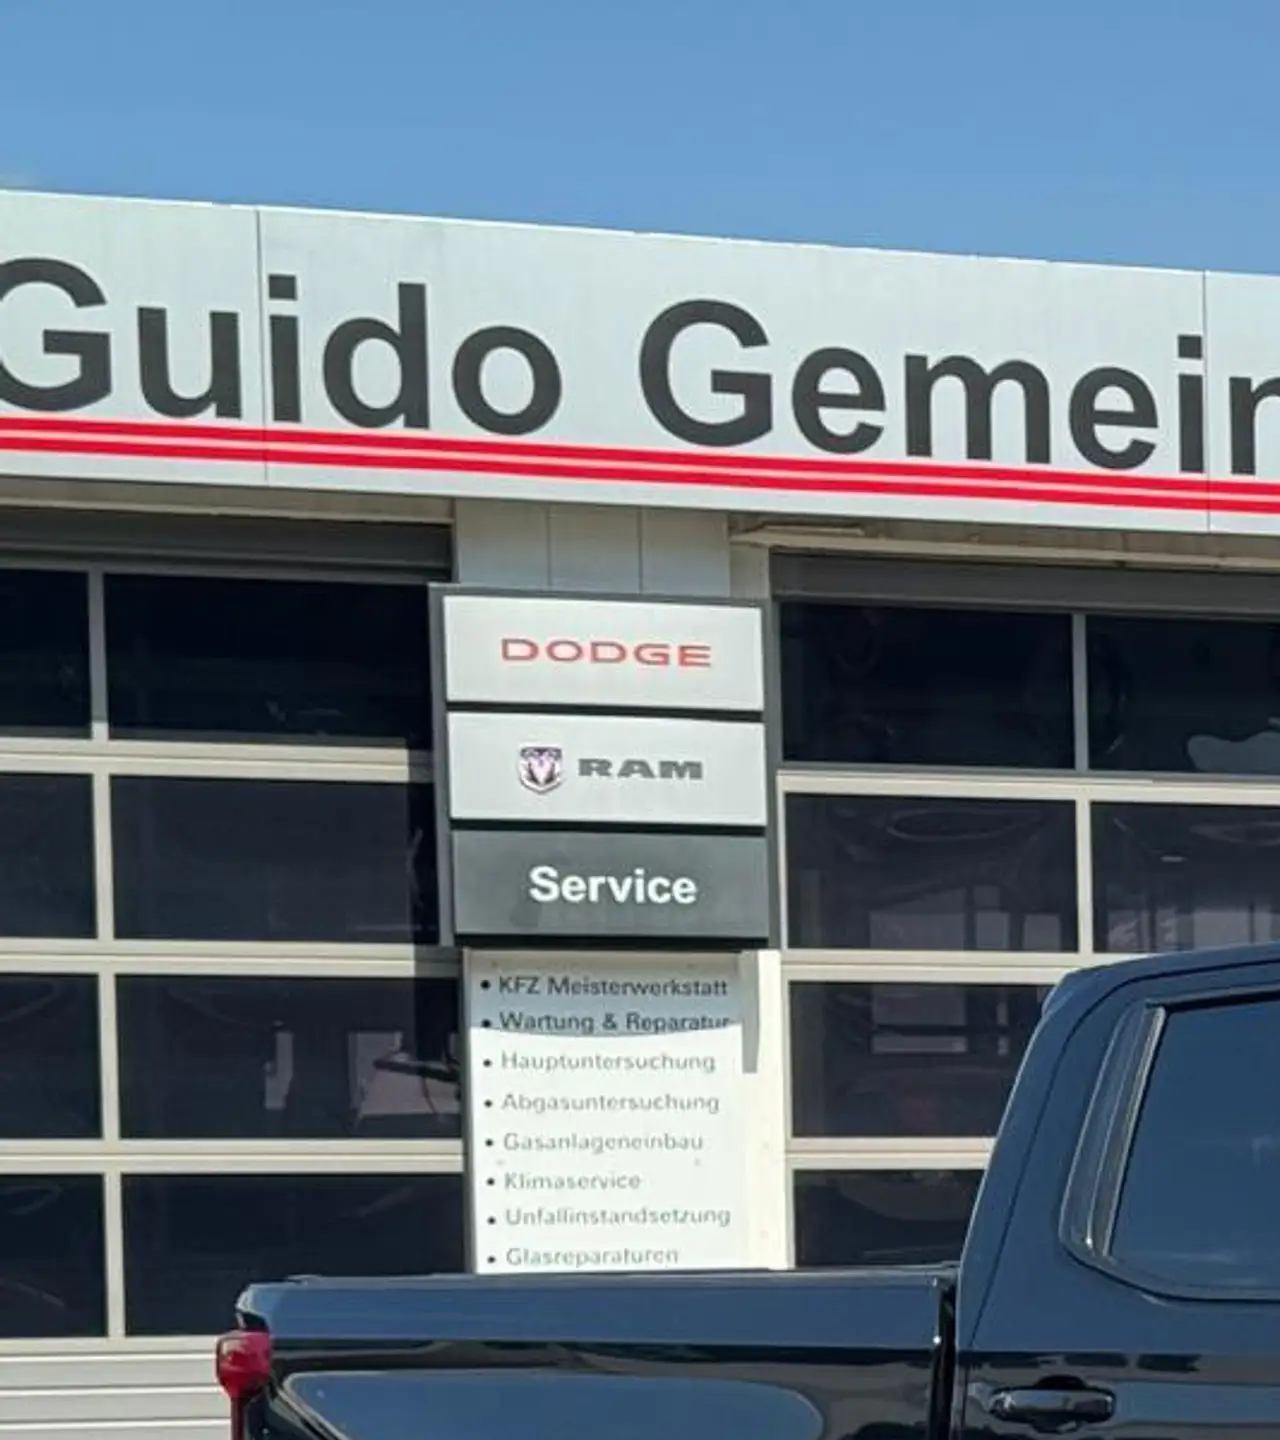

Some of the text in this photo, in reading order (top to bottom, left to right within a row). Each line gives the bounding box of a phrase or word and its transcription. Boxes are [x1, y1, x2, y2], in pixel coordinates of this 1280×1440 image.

[0, 257, 562, 436] Guido
[501, 638, 711, 668] DODGE
[578, 758, 703, 780] RAM
[529, 865, 697, 904] Service
[499, 976, 728, 997] KFZ Meisterwerkstatt
[499, 1011, 595, 1034] Wartung
[602, 1013, 617, 1031] &
[501, 1050, 716, 1073] Hauptuntersuchung
[501, 1093, 720, 1114] Abgasuntersuchung
[503, 1132, 704, 1154] Gasanlageneinbau
[503, 1172, 642, 1190] Klimaservice
[505, 1207, 732, 1228] Unfallinstandsetzung
[506, 1248, 679, 1268] Glasreparaturen
